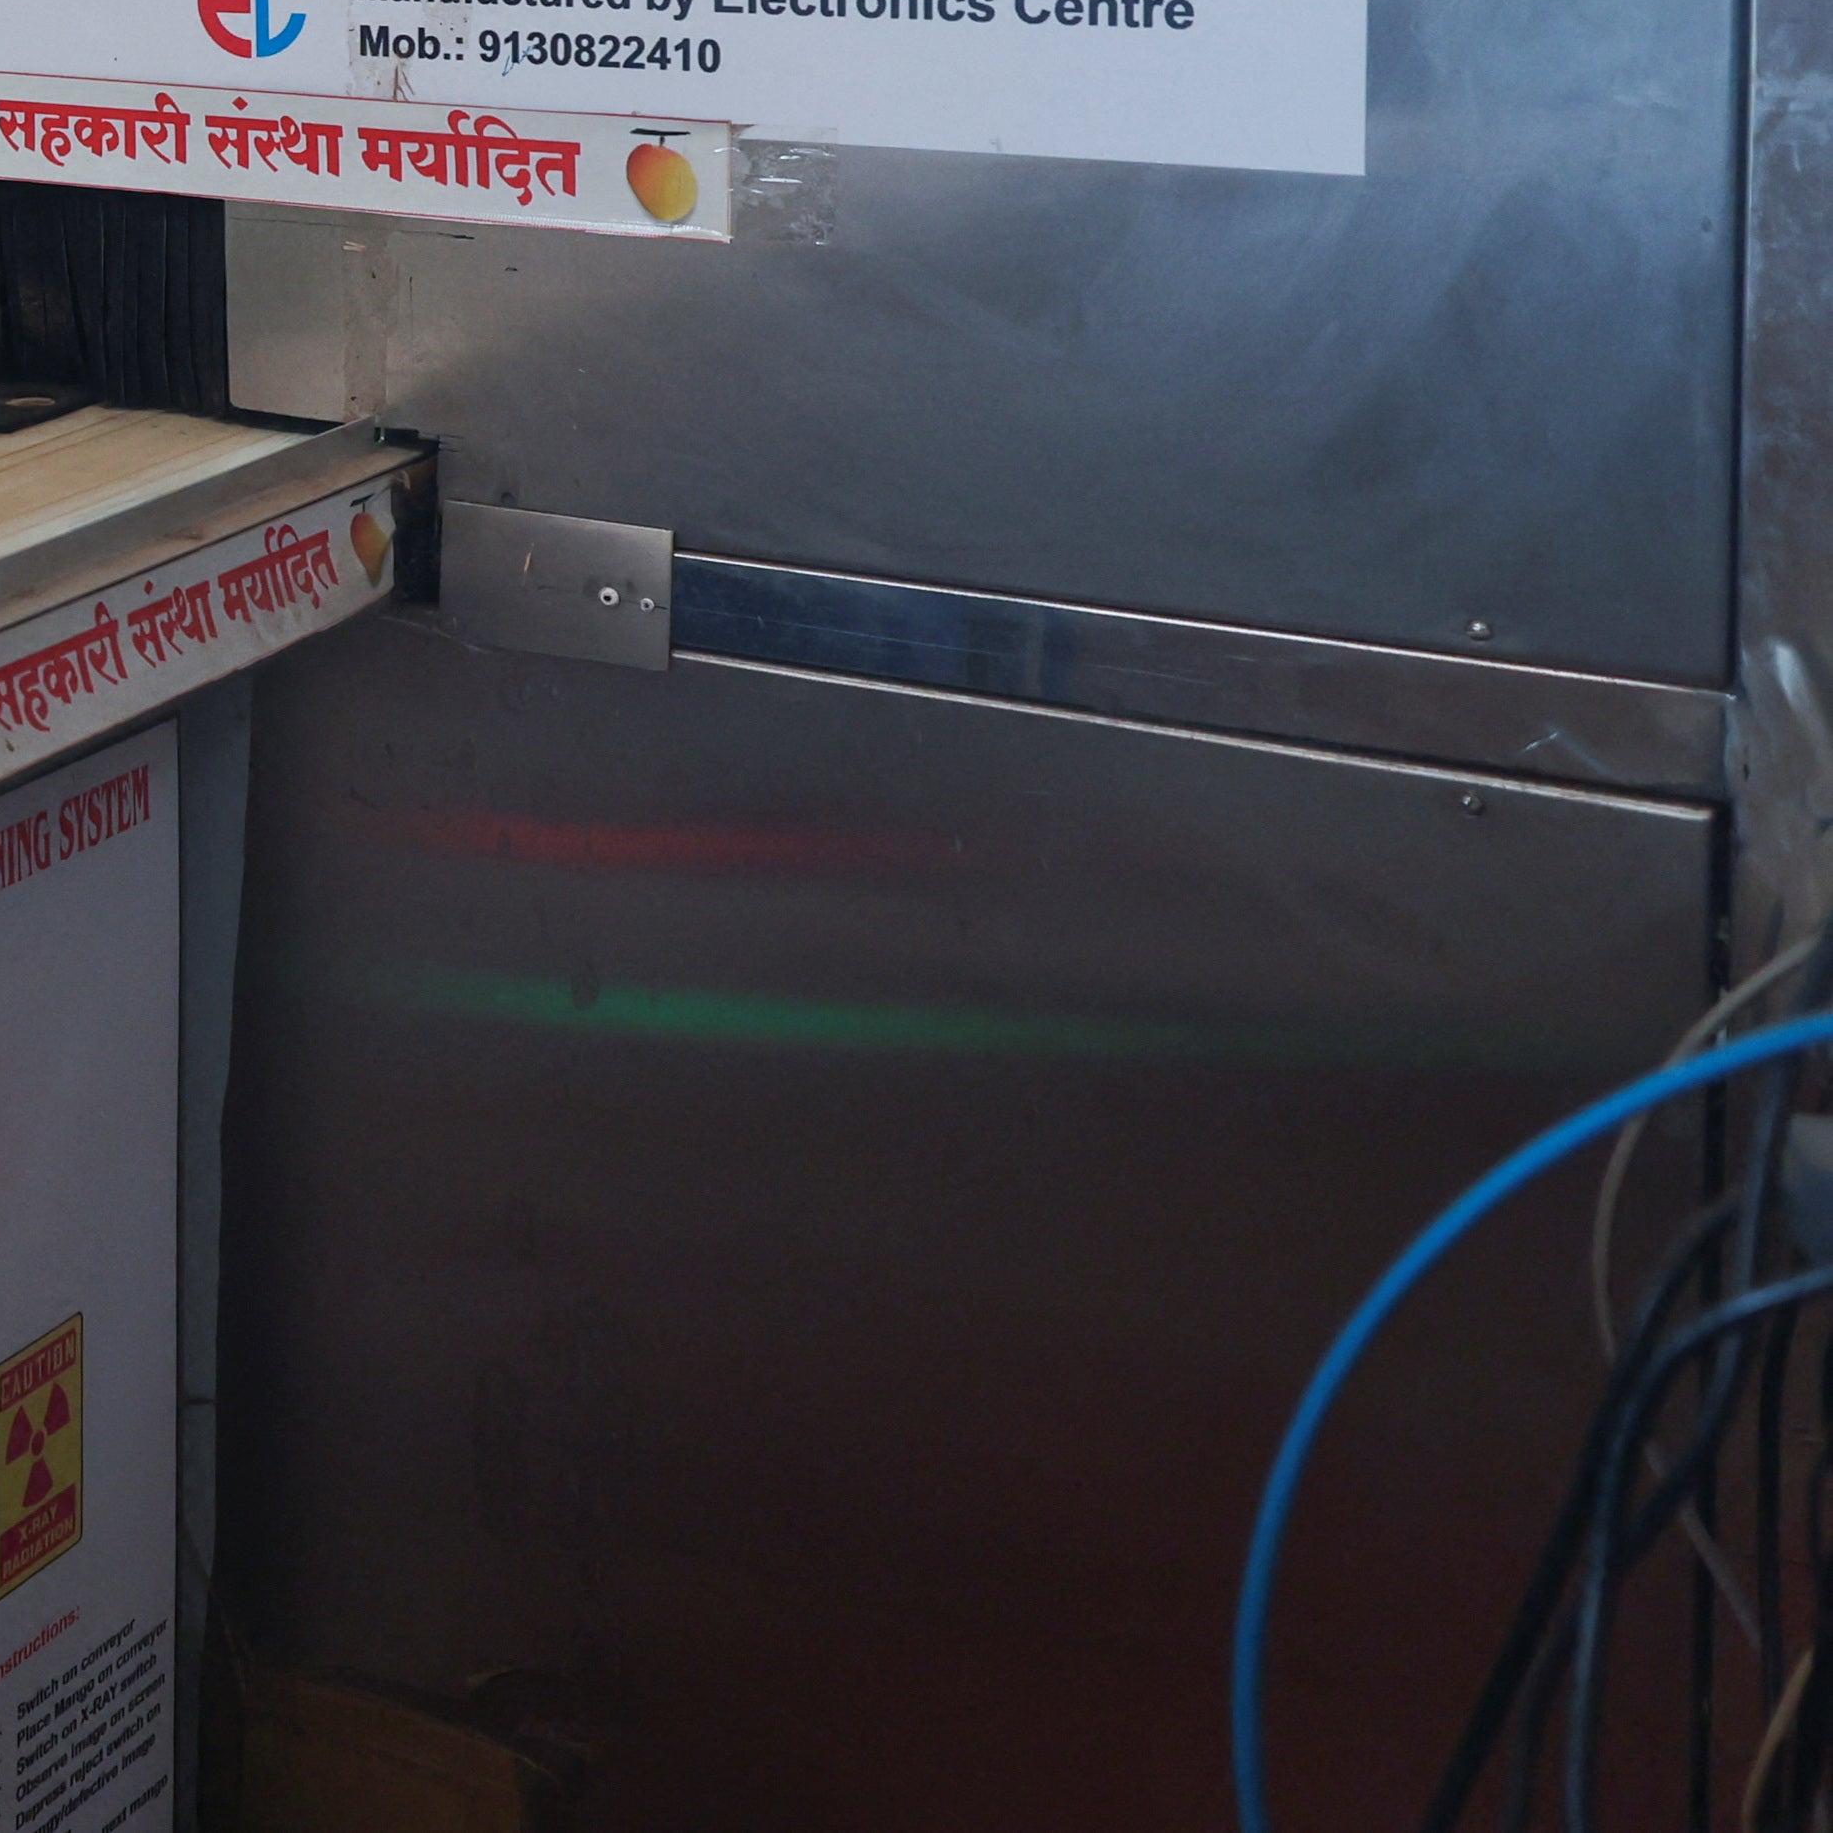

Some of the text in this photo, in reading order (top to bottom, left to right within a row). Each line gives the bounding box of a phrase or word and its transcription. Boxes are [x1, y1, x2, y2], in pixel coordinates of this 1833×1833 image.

[358, 25, 722, 73] Mob.: 9130822410
[205, 96, 344, 177] संस्था
[358, 109, 581, 206] मर्यादित
[127, 579, 219, 669] संस्था
[218, 524, 340, 625] मर्यादित
[57, 763, 151, 862] SYSTEM
[1, 1332, 75, 1404] CAUTION
[2, 1513, 74, 1580] RADIATION
[18, 1502, 59, 1545] X-RAY
[16, 1713, 52, 1748] Place
[54, 1678, 96, 1720] Mango
[97, 1662, 113, 1685] on
[115, 1618, 168, 1671] conveyor
[17, 1678, 59, 1721] Switch
[61, 1667, 78, 1687] on
[81, 1618, 136, 1671] conveyor
[17, 1734, 59, 1776] Switch
[61, 1719, 78, 1739] on
[80, 1682, 119, 1724] X-RAY
[120, 1653, 157, 1693] switch
[15, 1754, 69, 1803] Observe
[110, 1706, 126, 1727] on
[128, 1672, 166, 1712] screen
[15, 1702, 162, 1831] Depress reject switch on
